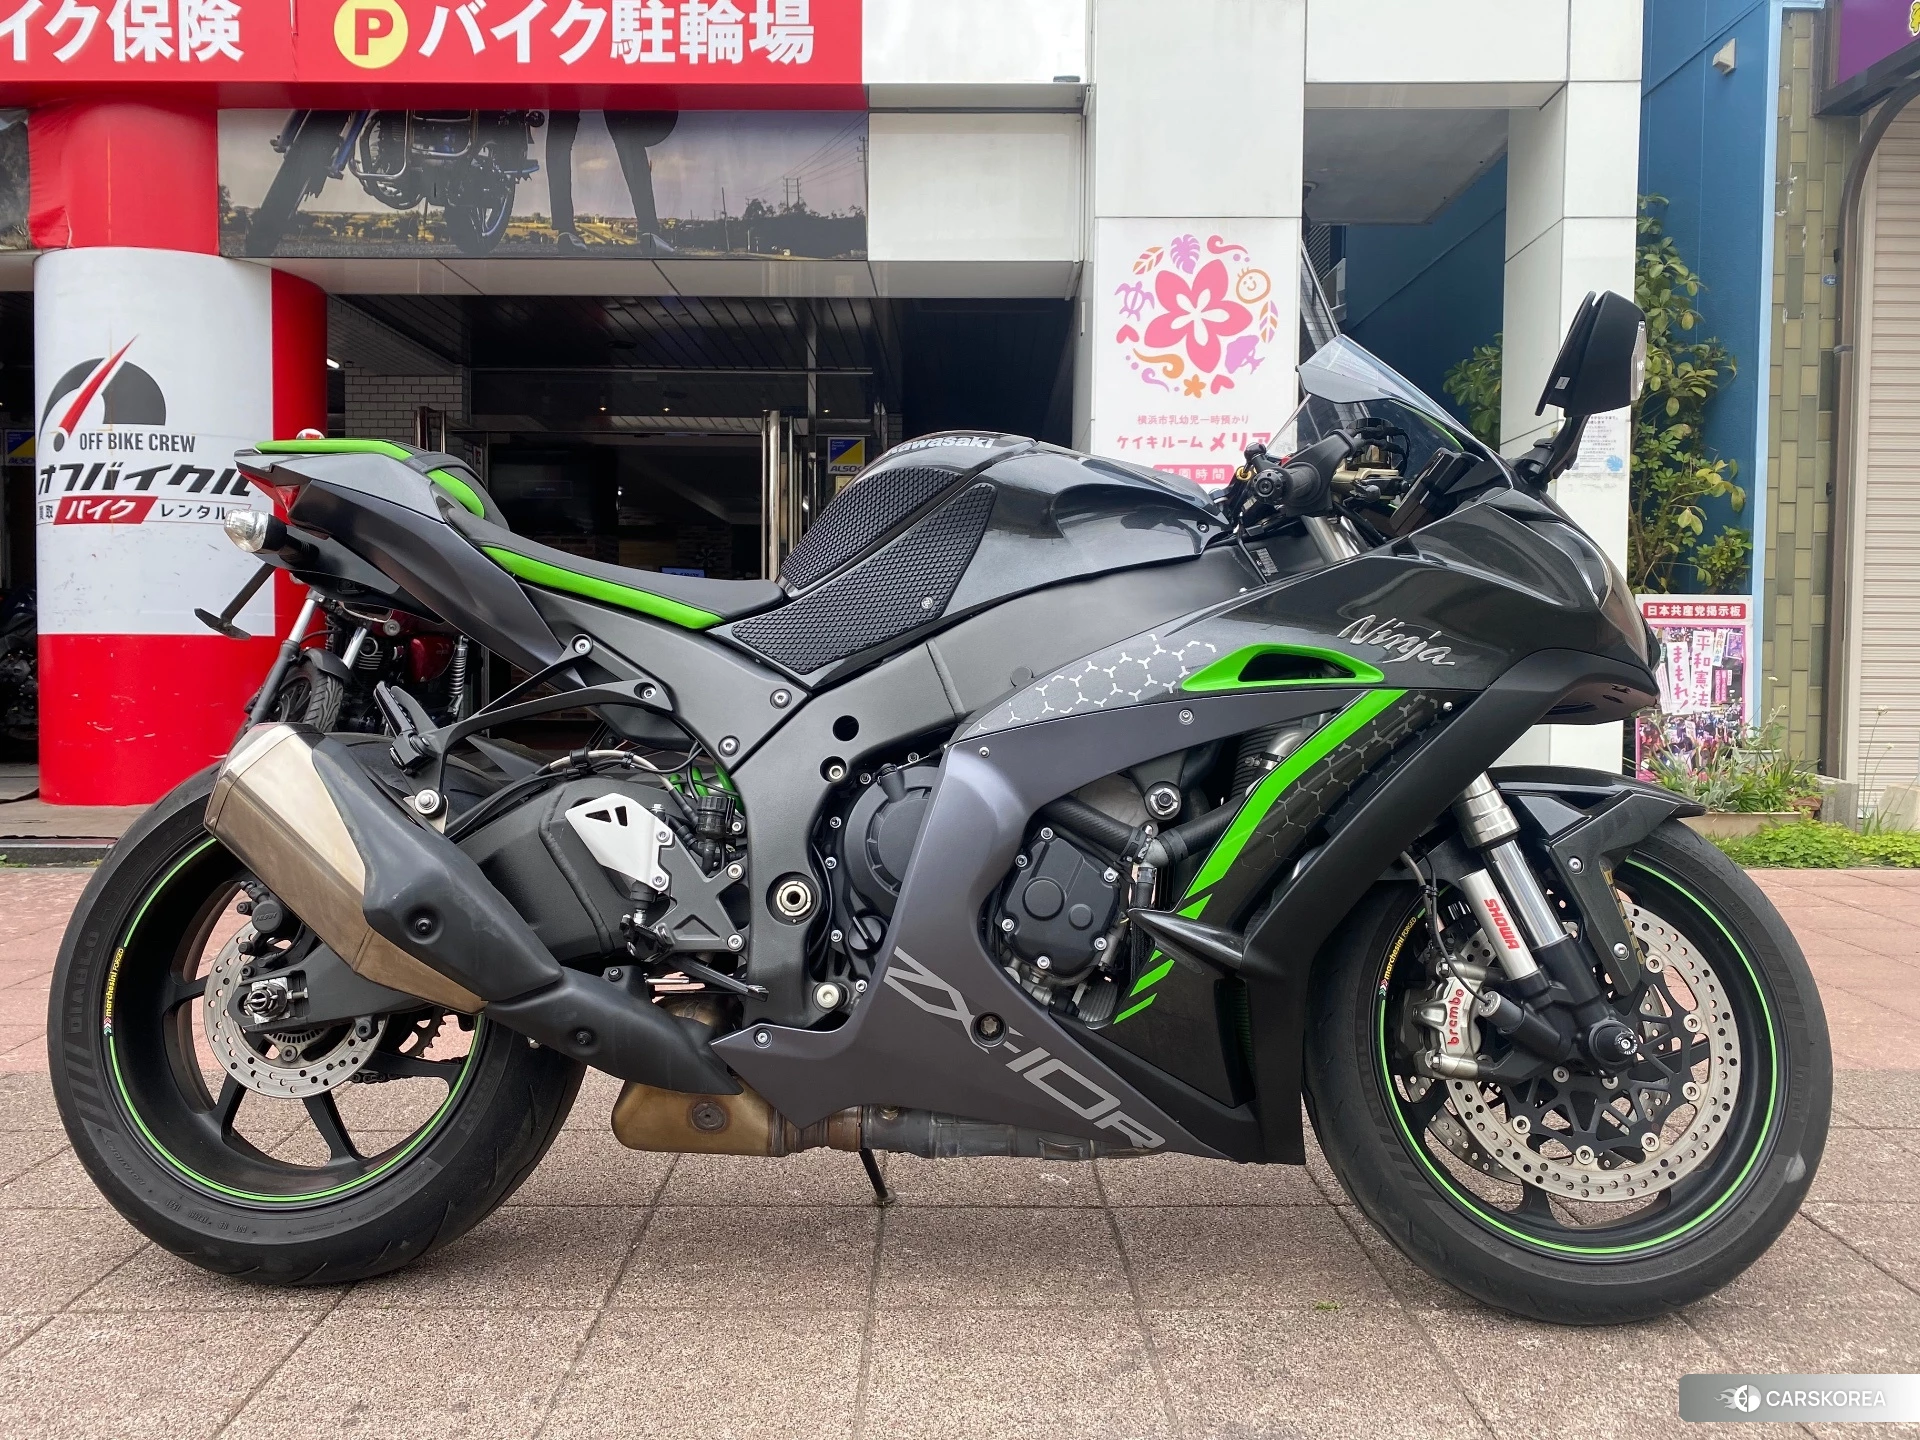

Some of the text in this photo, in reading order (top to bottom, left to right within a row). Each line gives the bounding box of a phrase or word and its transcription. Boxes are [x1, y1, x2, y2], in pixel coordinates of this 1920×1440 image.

[354, 0, 814, 65] P バイク駐輪場
[79, 432, 196, 453] OFF BIKE CREW
[1116, 435, 1204, 449] ケイキルーム
[1137, 415, 1249, 425] 横浜市乳幼児一時預かり
[65, 500, 137, 519] バイク
[1647, 604, 1741, 617] 日本共産党掲示板
[1336, 614, 1457, 666] Ninja
[1692, 634, 1711, 708] 平和憲法
[1384, 916, 1418, 980] marchesini FORGED
[1483, 898, 1520, 950] SHOWA
[105, 970, 118, 1018] marchesini
[1447, 988, 1465, 1046] brembo
[883, 946, 1166, 1149] ZX-10R
